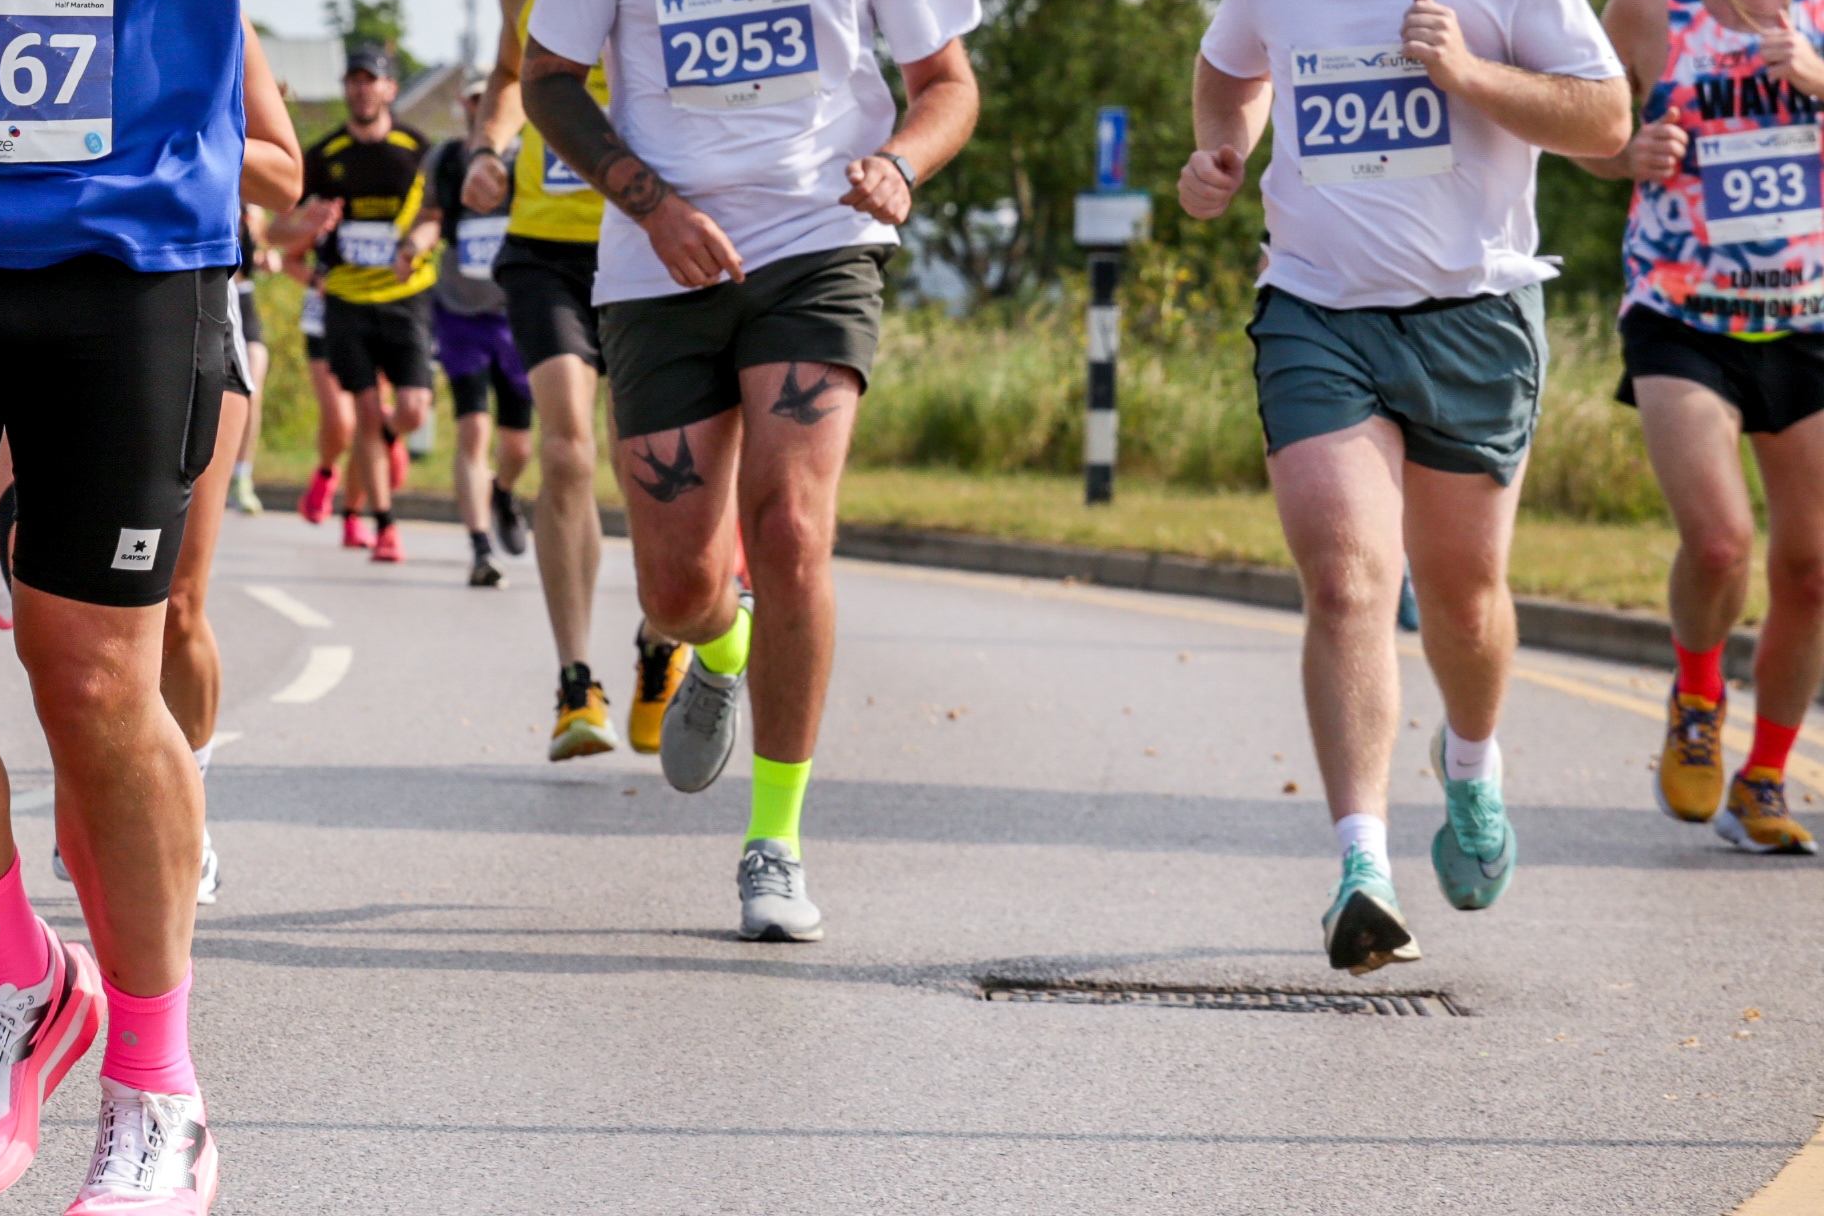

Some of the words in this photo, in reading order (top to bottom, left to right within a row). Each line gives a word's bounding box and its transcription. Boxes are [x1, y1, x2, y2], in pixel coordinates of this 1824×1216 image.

[670, 17, 807, 82] 2953
[1301, 87, 1441, 146] 2940
[1694, 75, 1824, 120] WAYN
[1723, 163, 1806, 212] 933
[1731, 268, 1803, 288] LONDON
